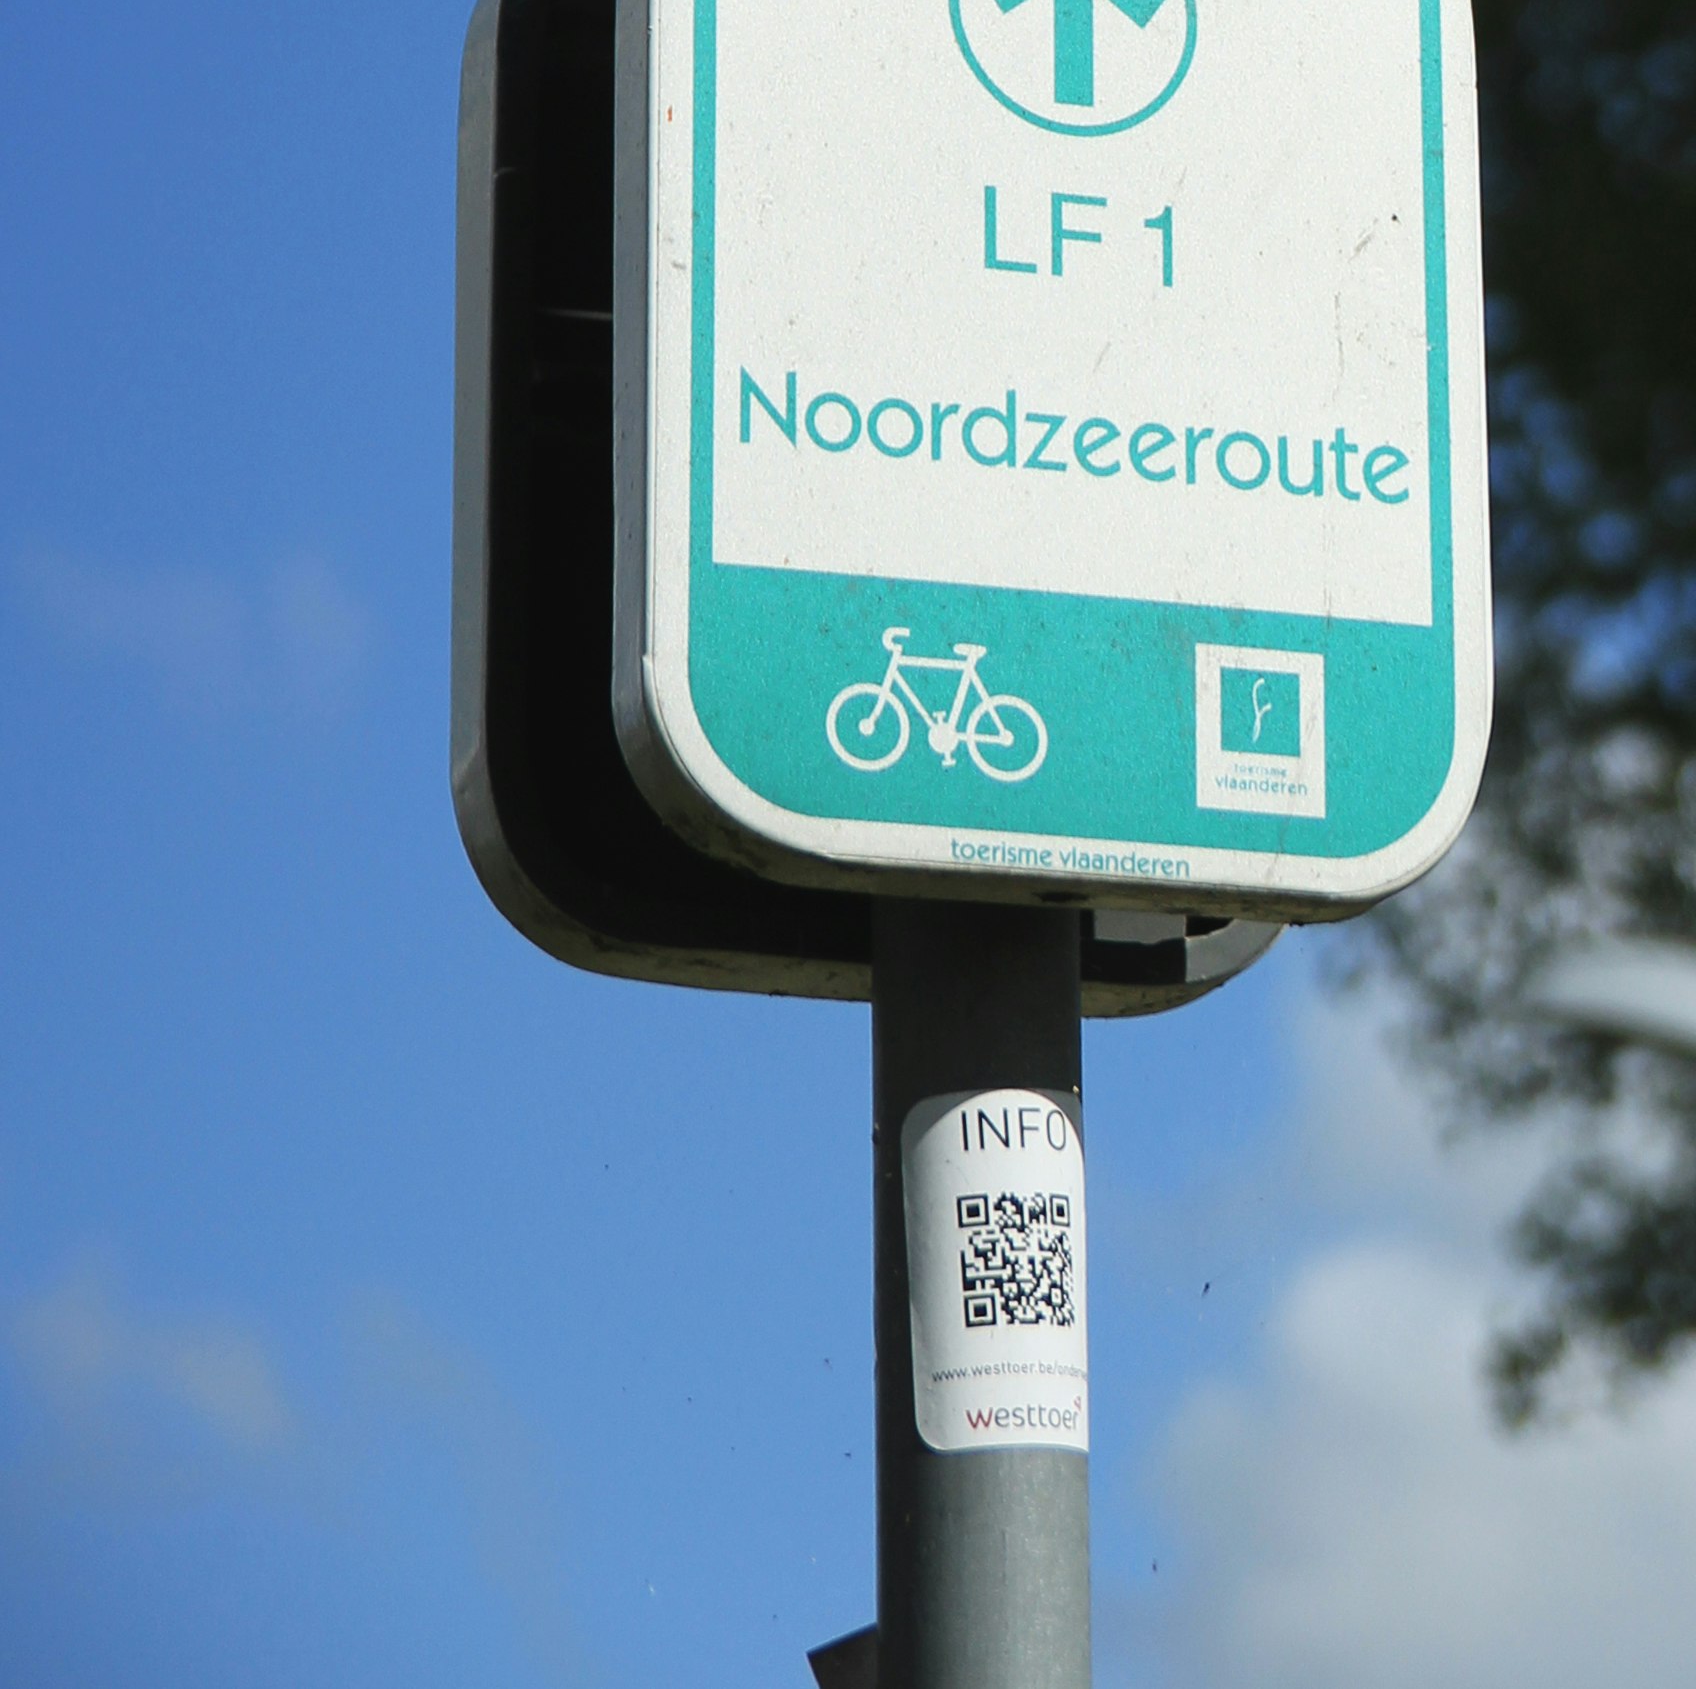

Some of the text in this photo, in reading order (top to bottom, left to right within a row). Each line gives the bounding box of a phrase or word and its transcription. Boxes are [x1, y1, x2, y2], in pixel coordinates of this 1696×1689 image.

[983, 184, 1176, 288] LF 1
[738, 366, 1411, 505] Noordzeeroute
[1215, 775, 1308, 796] vlaanderen
[950, 837, 1191, 878] toerisme vlaanderen
[961, 1108, 1067, 1152] INFO
[966, 1401, 1080, 1431] westtoer
